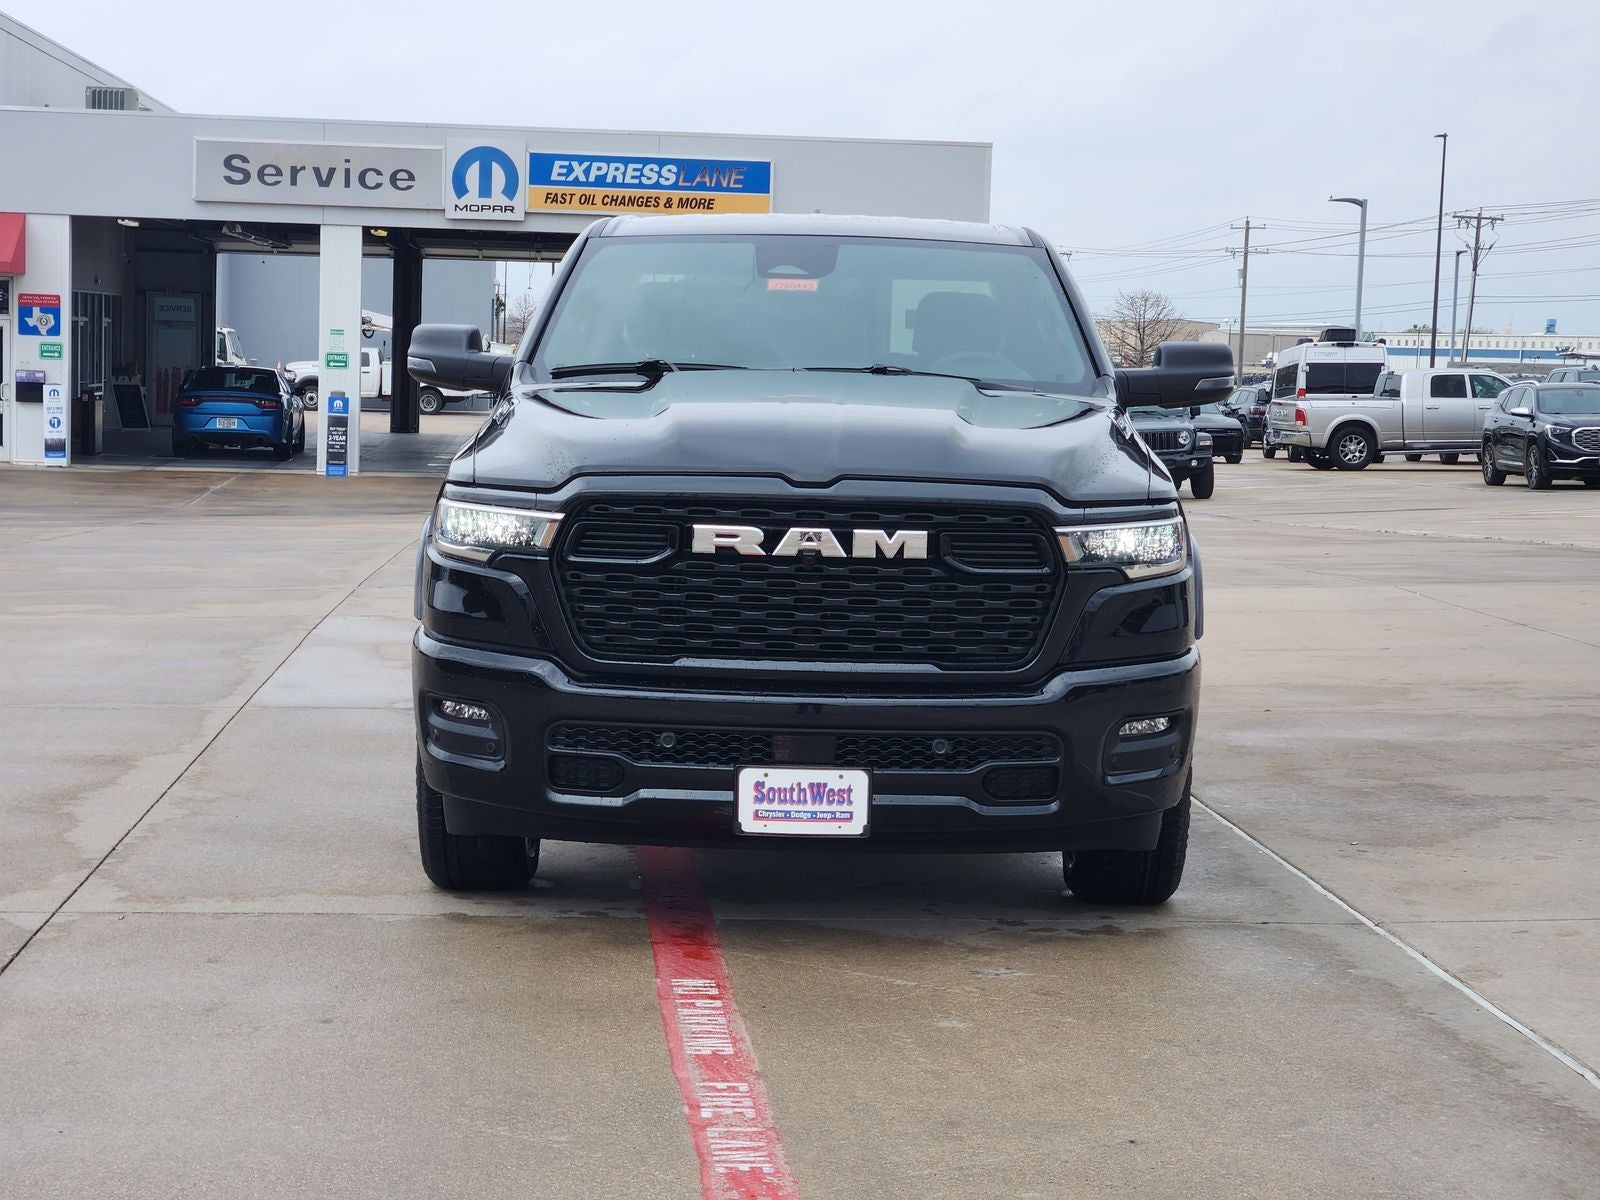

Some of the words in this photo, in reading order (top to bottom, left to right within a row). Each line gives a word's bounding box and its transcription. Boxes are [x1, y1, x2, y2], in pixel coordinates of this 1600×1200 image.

[222, 153, 416, 191] Service
[454, 203, 515, 215] MOPAR
[544, 192, 576, 206] FAST
[578, 193, 598, 207] OIL
[601, 194, 661, 209] CHANGES
[663, 197, 674, 210] &
[677, 197, 716, 211] MORE
[41, 344, 61, 352] ENTRANCE
[327, 354, 347, 362] ENTRANCE
[691, 524, 929, 559] RAM
[757, 810, 785, 820] Chrysler
[790, 811, 812, 821] Dodge
[817, 812, 832, 821] Jeep
[836, 812, 851, 820] Ram
[675, 999, 735, 1055] PARKING
[695, 1082, 756, 1119] FIRE
[706, 1126, 776, 1174] LANE
